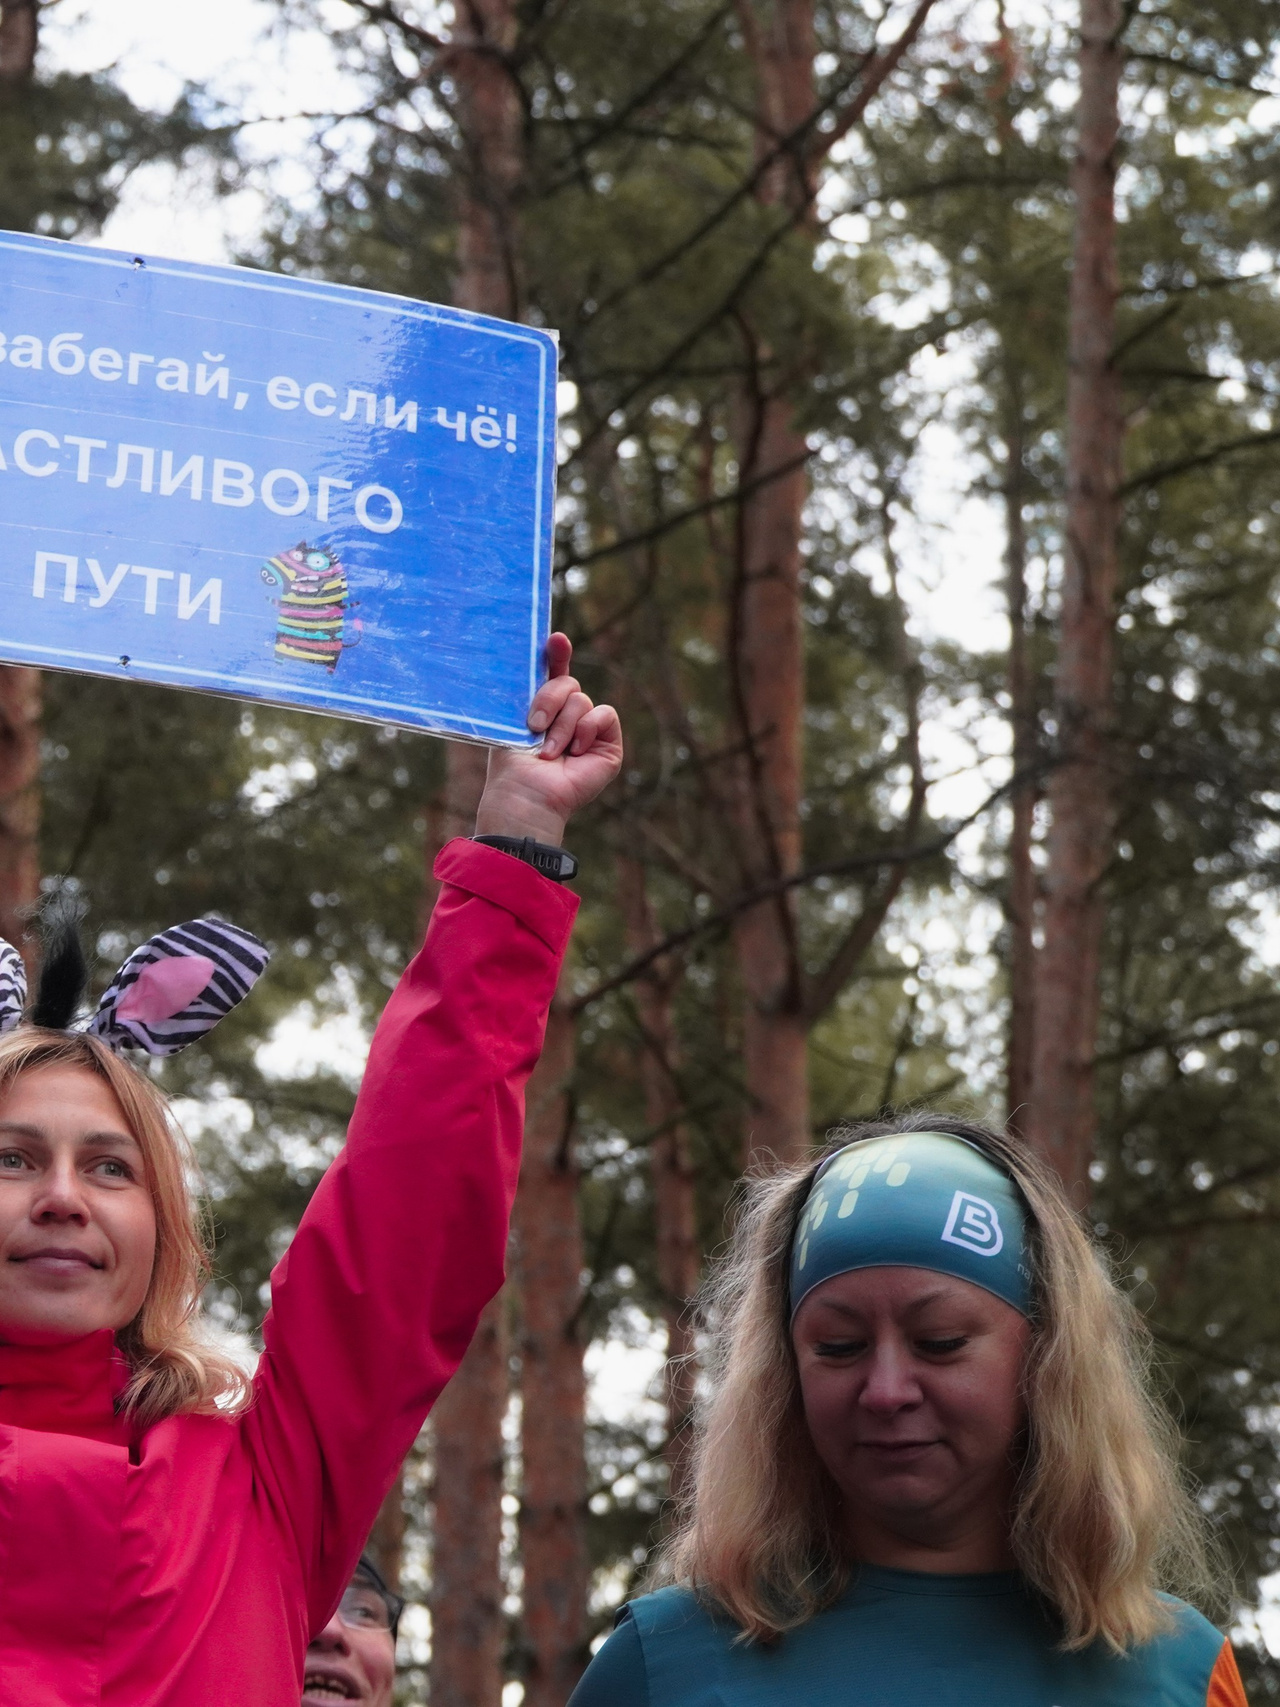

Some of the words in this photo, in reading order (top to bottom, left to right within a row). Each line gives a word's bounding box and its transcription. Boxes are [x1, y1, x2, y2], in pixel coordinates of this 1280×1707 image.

[266, 374, 418, 434] если
[436, 404, 518, 454] чё!
[32, 550, 222, 626] ПУТИ
